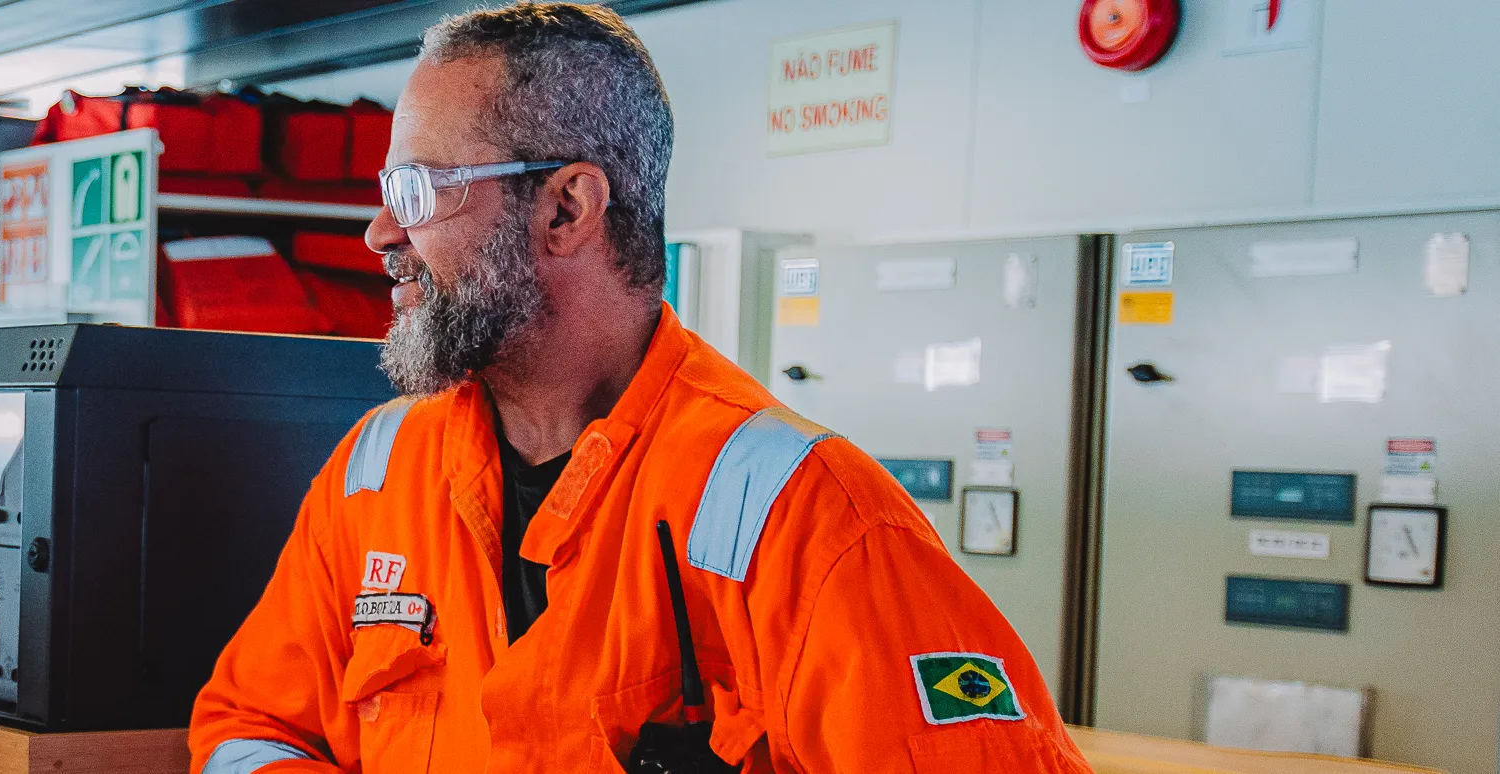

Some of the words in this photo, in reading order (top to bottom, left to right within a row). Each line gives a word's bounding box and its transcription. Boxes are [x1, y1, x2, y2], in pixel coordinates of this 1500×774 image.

[828, 44, 878, 76] FUME
[771, 106, 795, 133] NO
[801, 94, 887, 131] SMOKING
[369, 558, 402, 584] RF
